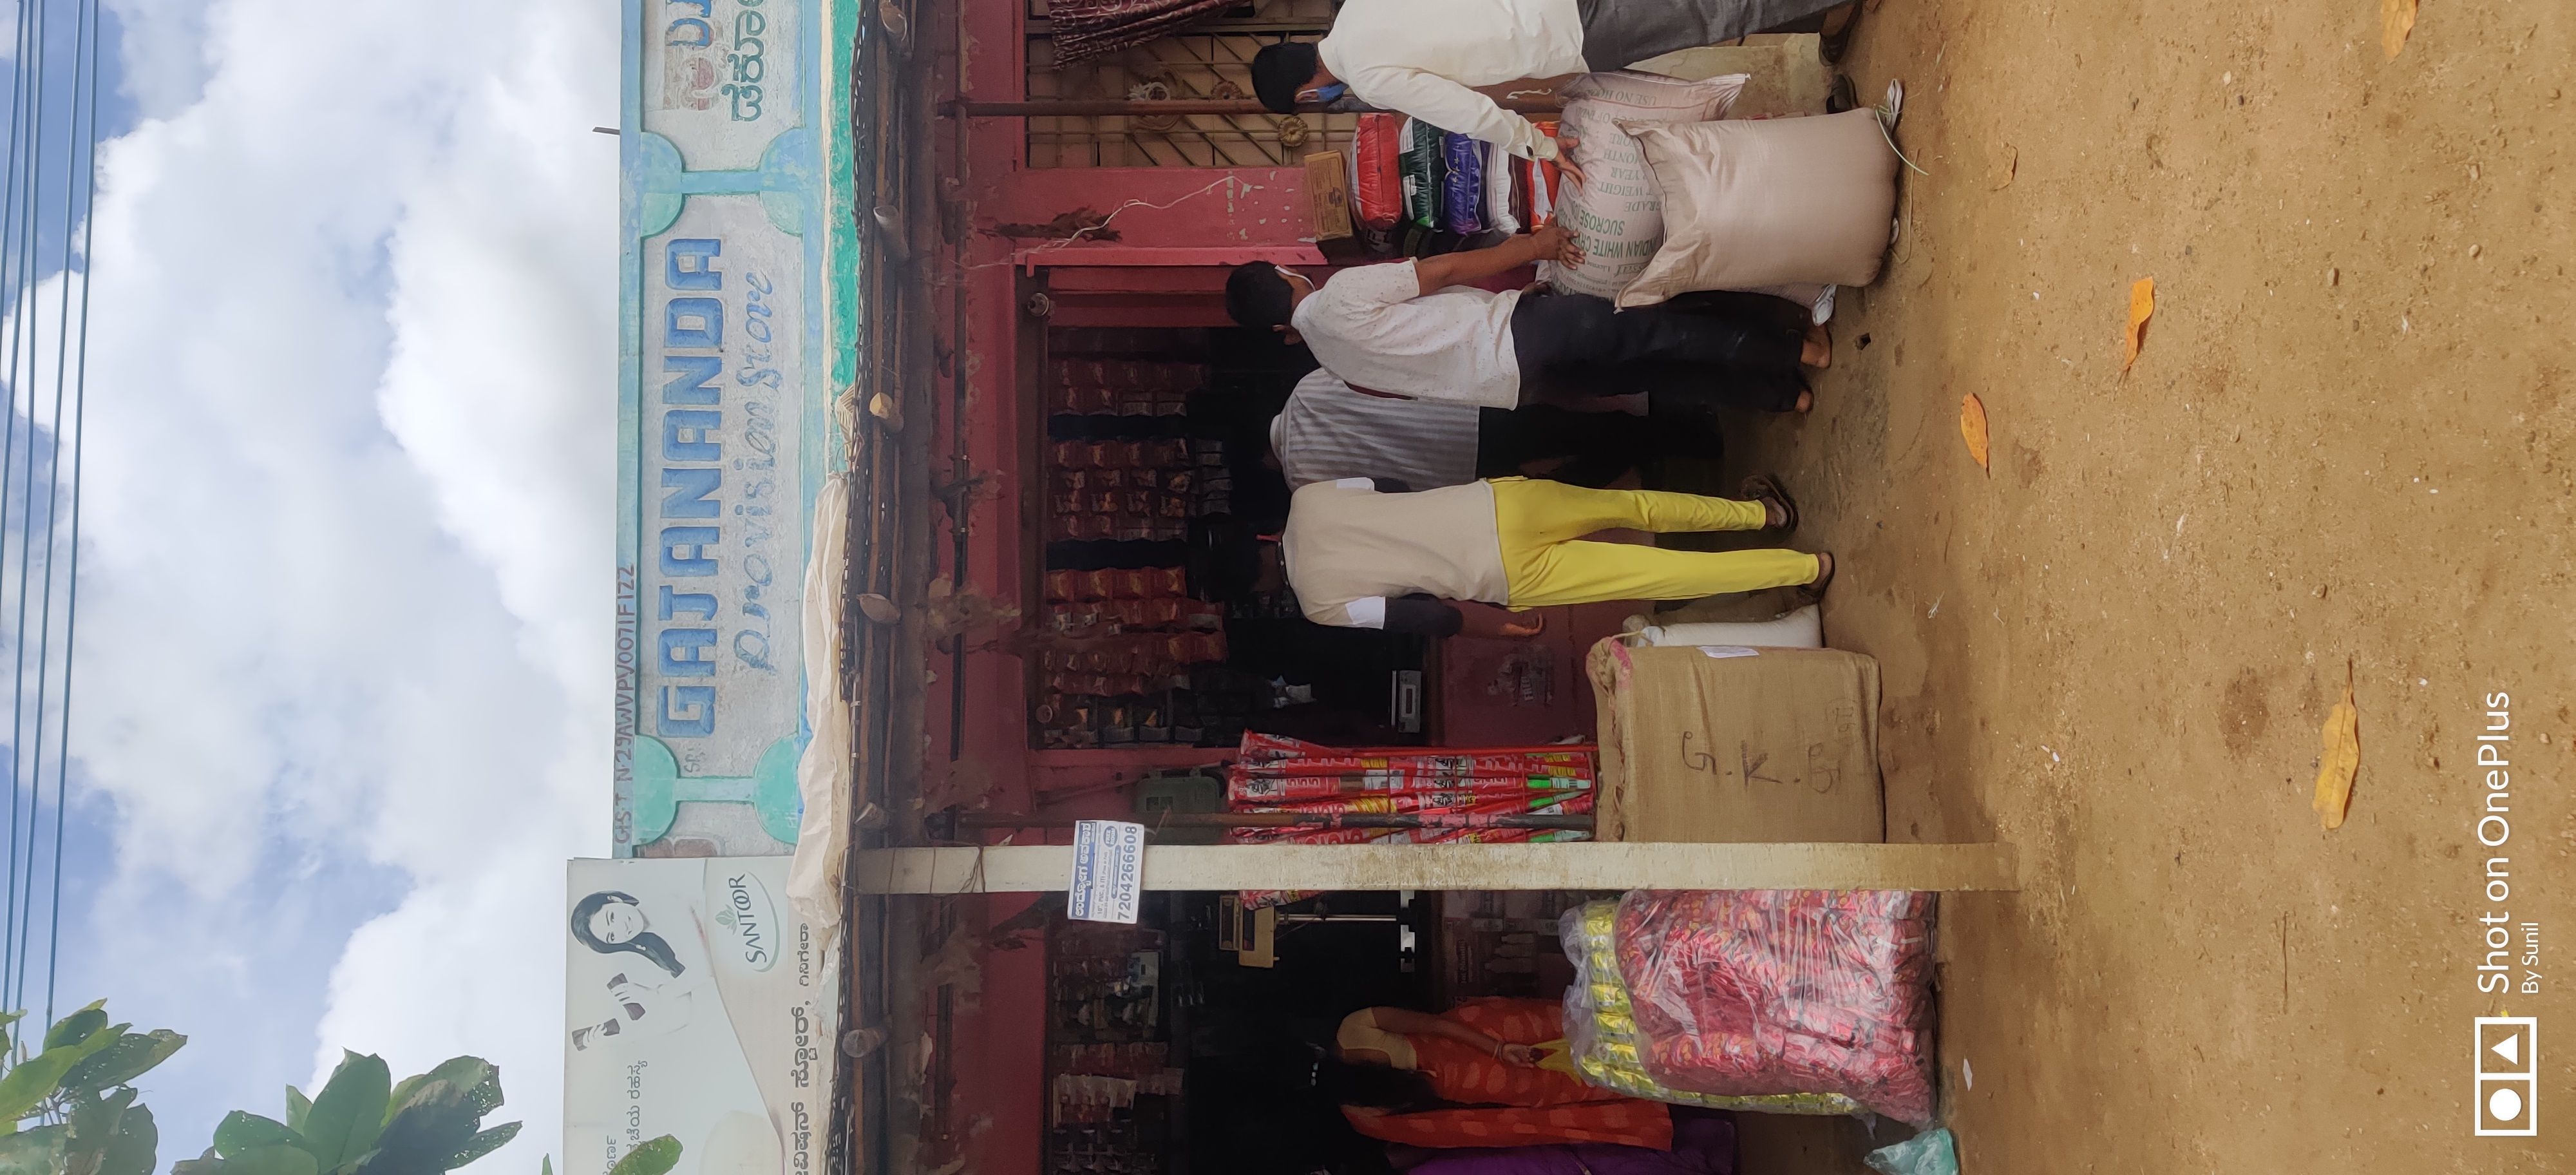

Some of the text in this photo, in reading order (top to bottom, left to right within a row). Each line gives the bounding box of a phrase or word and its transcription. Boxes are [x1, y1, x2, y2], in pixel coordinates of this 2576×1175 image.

[1615, 91, 1634, 103] NO
[1636, 93, 1657, 107] USE
[1596, 181, 1643, 197] WEIGHT
[1609, 166, 1640, 181] YEAR
[1579, 209, 1625, 236] SUCROSE
[1593, 238, 1624, 258] WHITE
[734, 271, 784, 392] Store
[656, 237, 723, 738] GAJANANDA
[1074, 822, 1092, 917] ಉದ್ಯೋಗ ಅವಕಾಶ
[1117, 826, 1137, 920] 7204266608
[728, 874, 767, 963] SANTOOR
[797, 922, 810, 987] ಗಿನಿಗೇರಾ
[791, 1000, 819, 1087] ಸ್ಟೋರ್,
[626, 1060, 648, 1100] ರಹಸ್ಯ
